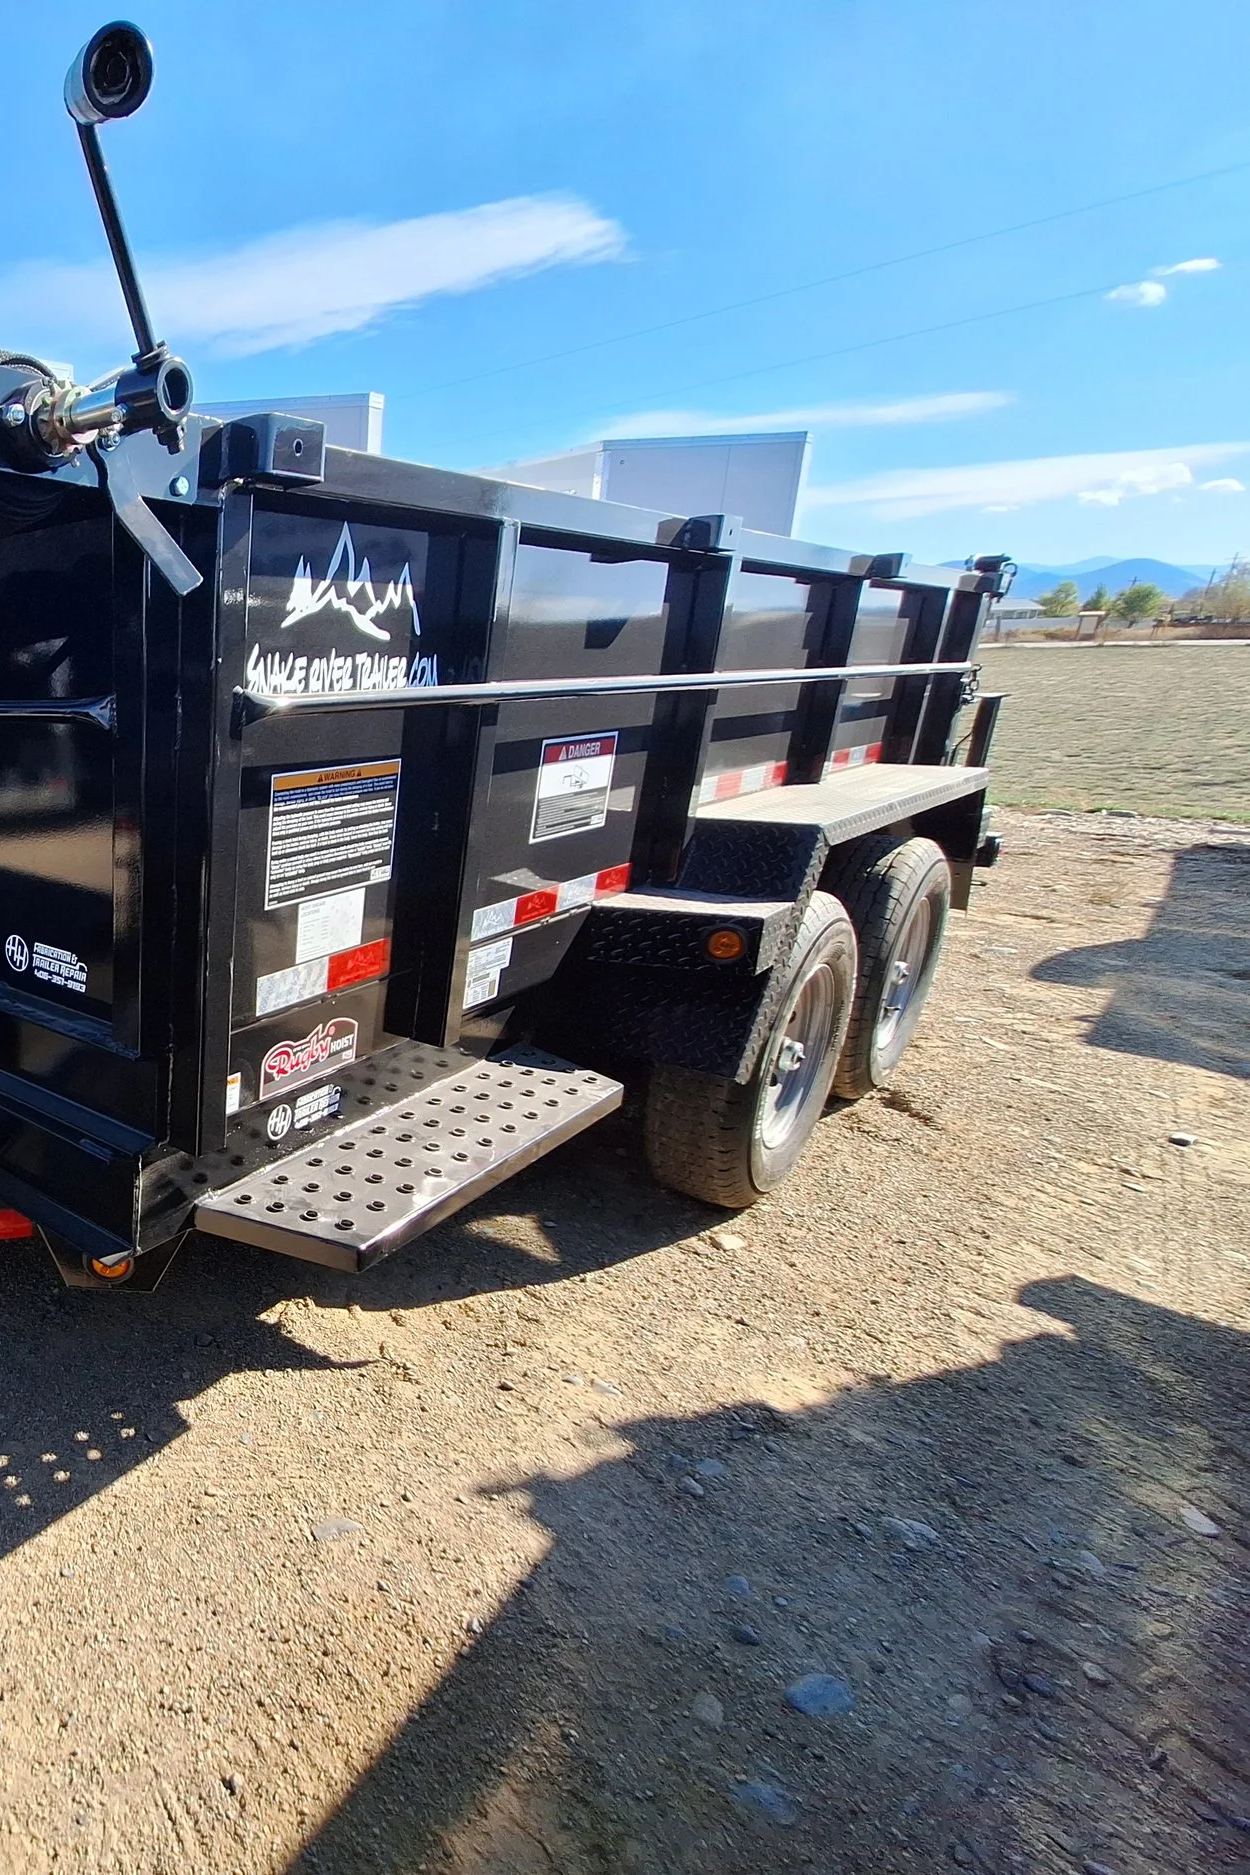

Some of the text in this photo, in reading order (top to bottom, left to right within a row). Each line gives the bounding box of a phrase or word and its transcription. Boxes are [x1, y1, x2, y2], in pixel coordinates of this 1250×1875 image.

[247, 642, 308, 695] SNAKE
[309, 647, 354, 693] RIVER
[568, 742, 601, 759] DANGER
[324, 769, 356, 780] WARNING
[34, 942, 71, 964] FABRICATION
[33, 953, 87, 982] TRAILER REPAIR
[265, 1034, 355, 1080] Rugby HOIST
